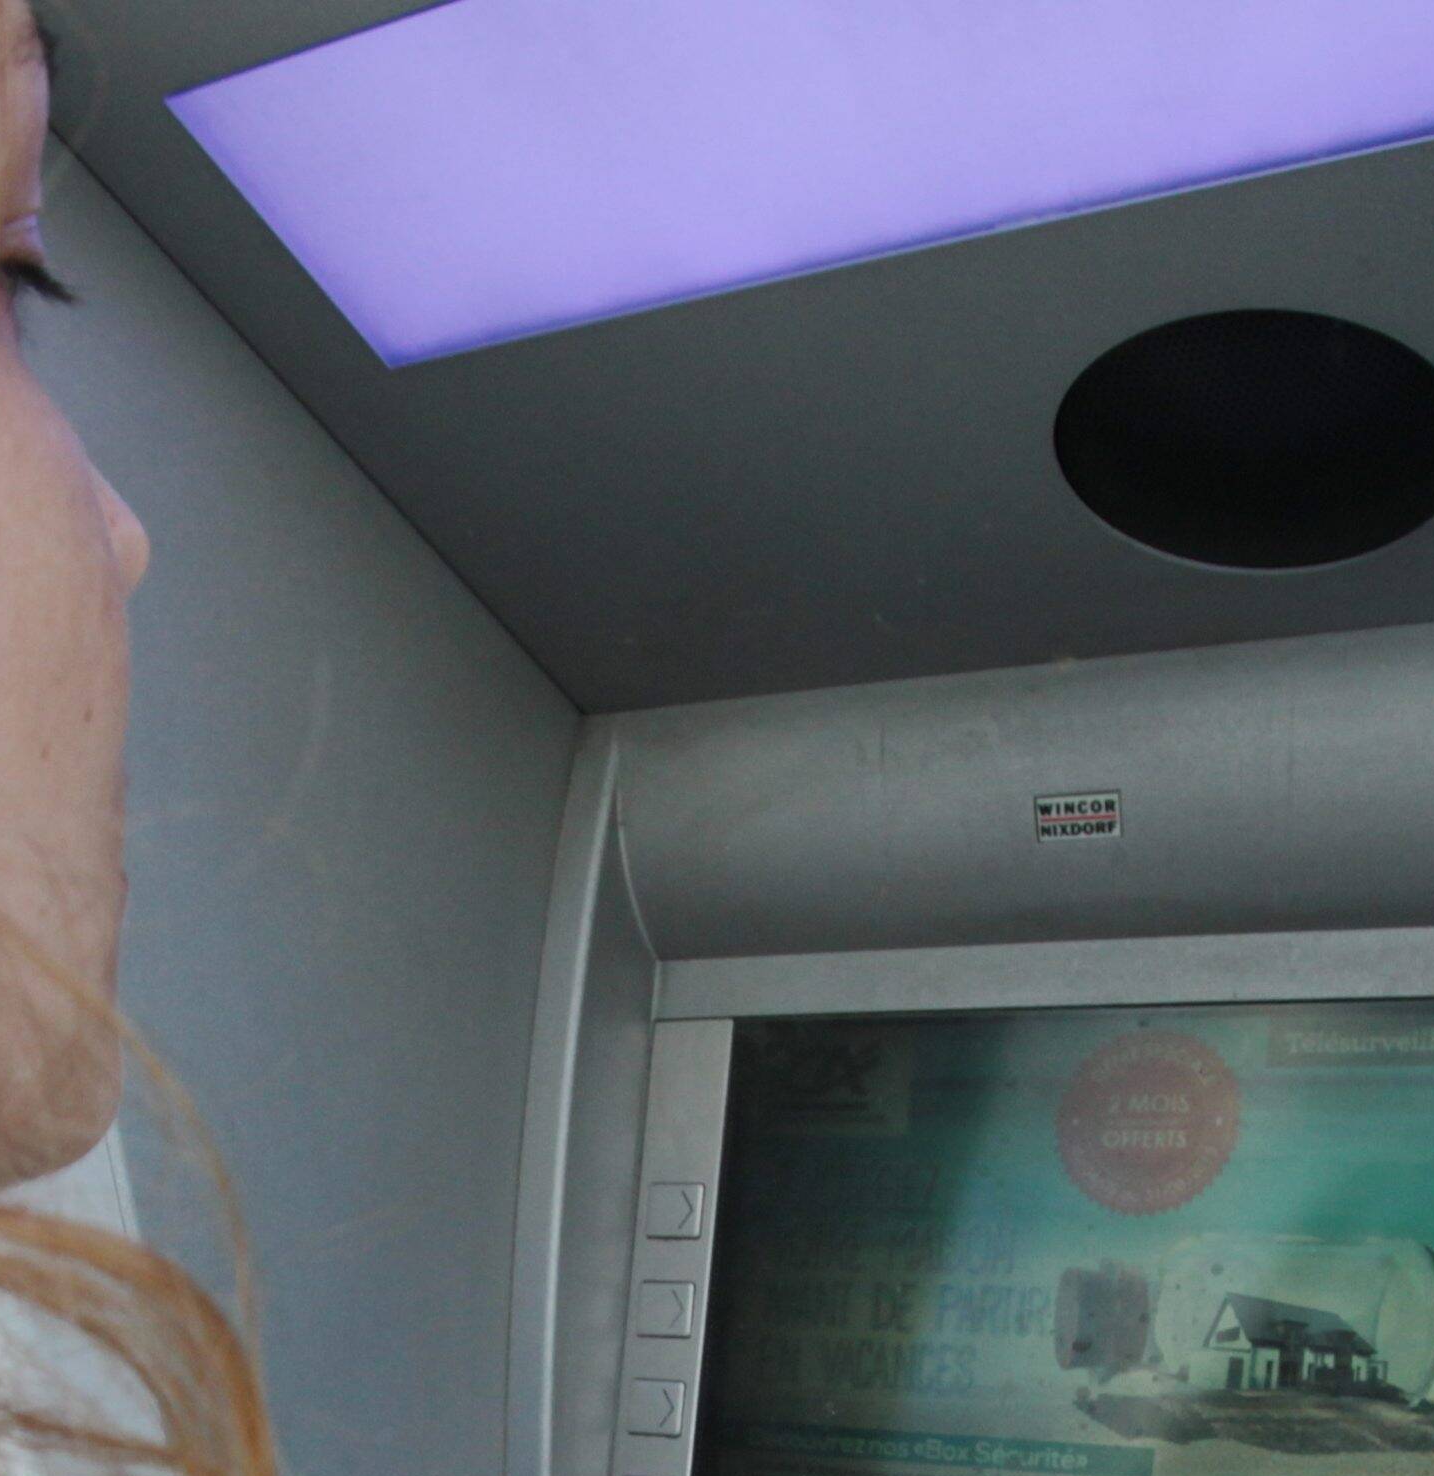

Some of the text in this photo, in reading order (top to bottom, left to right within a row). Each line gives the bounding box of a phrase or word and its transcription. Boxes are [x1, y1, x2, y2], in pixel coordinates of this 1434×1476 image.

[1038, 799, 1116, 815] WINCOR
[1041, 821, 1116, 837] NIXDORF
[1128, 1092, 1190, 1114] MOIS
[1101, 1128, 1188, 1149] OFFERTS
